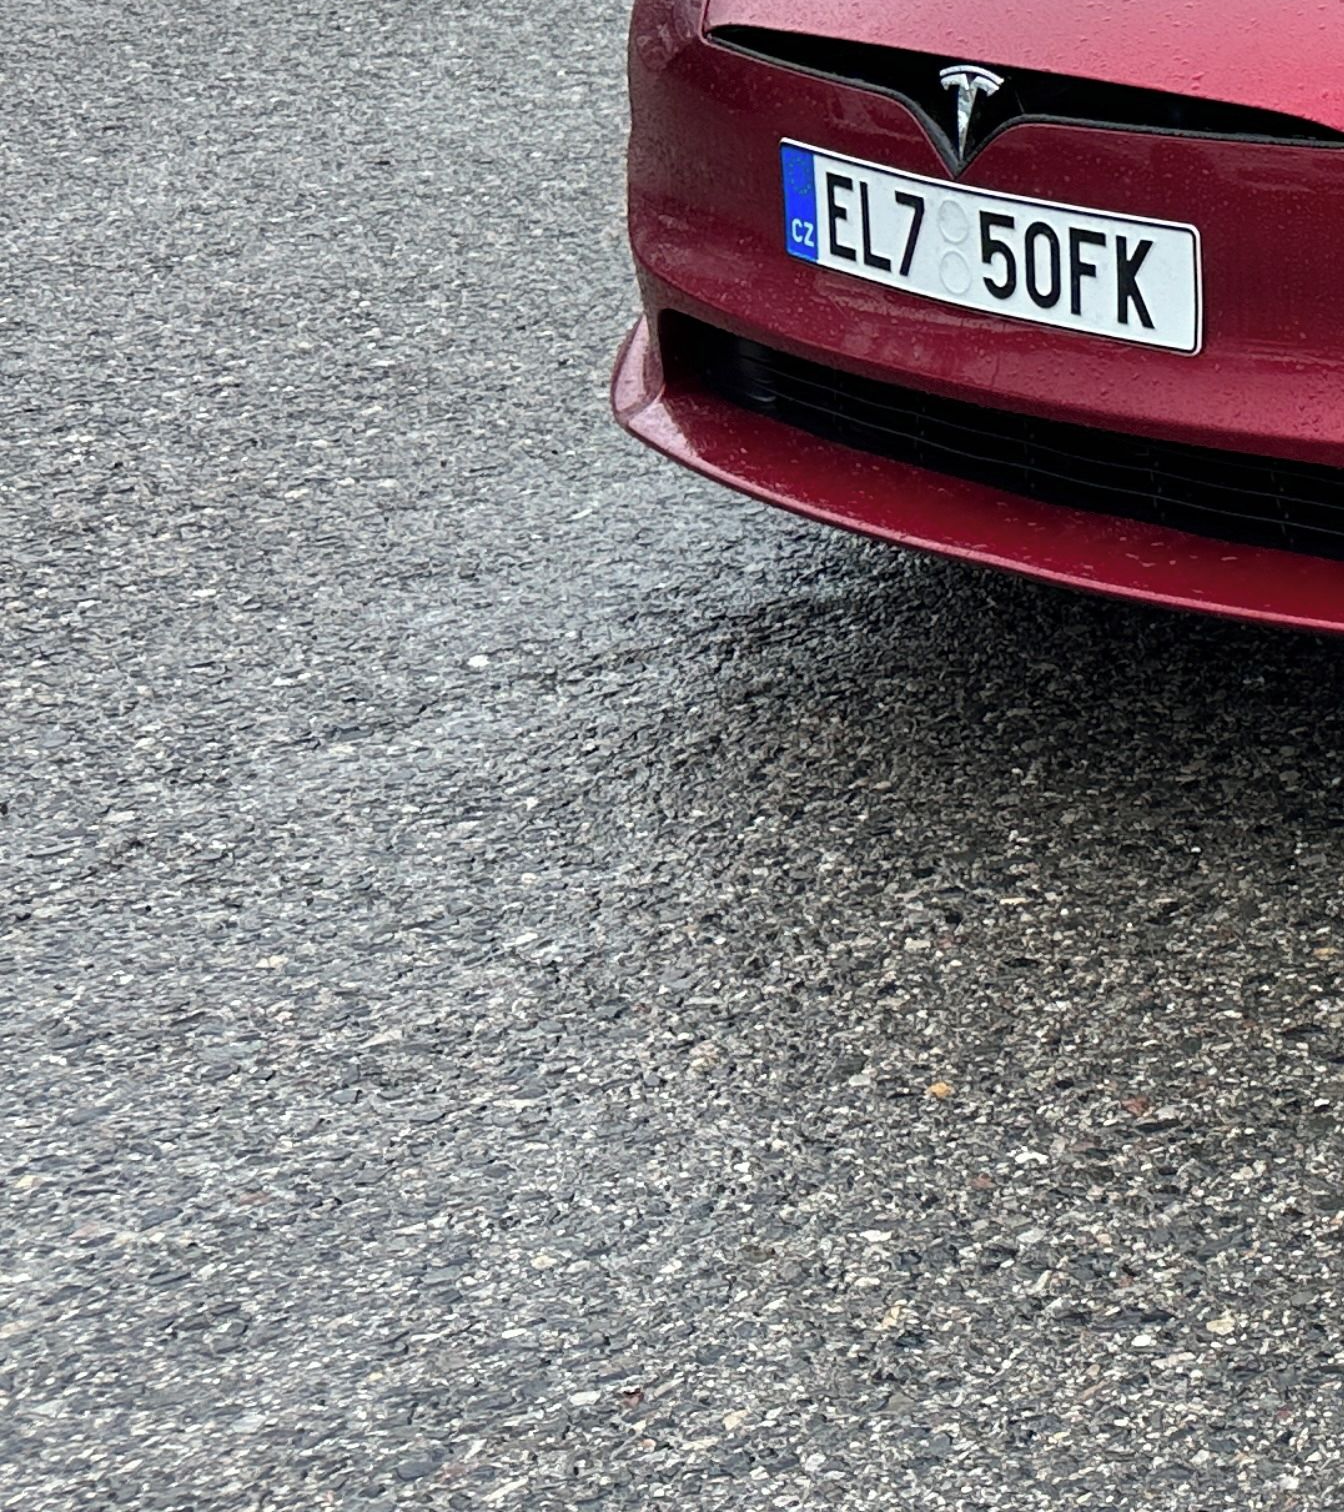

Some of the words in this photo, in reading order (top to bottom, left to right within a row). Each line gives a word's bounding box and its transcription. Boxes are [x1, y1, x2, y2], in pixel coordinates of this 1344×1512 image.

[790, 216, 816, 248] CZ
[824, 171, 926, 277] EL7
[978, 209, 1157, 331] 50FK
